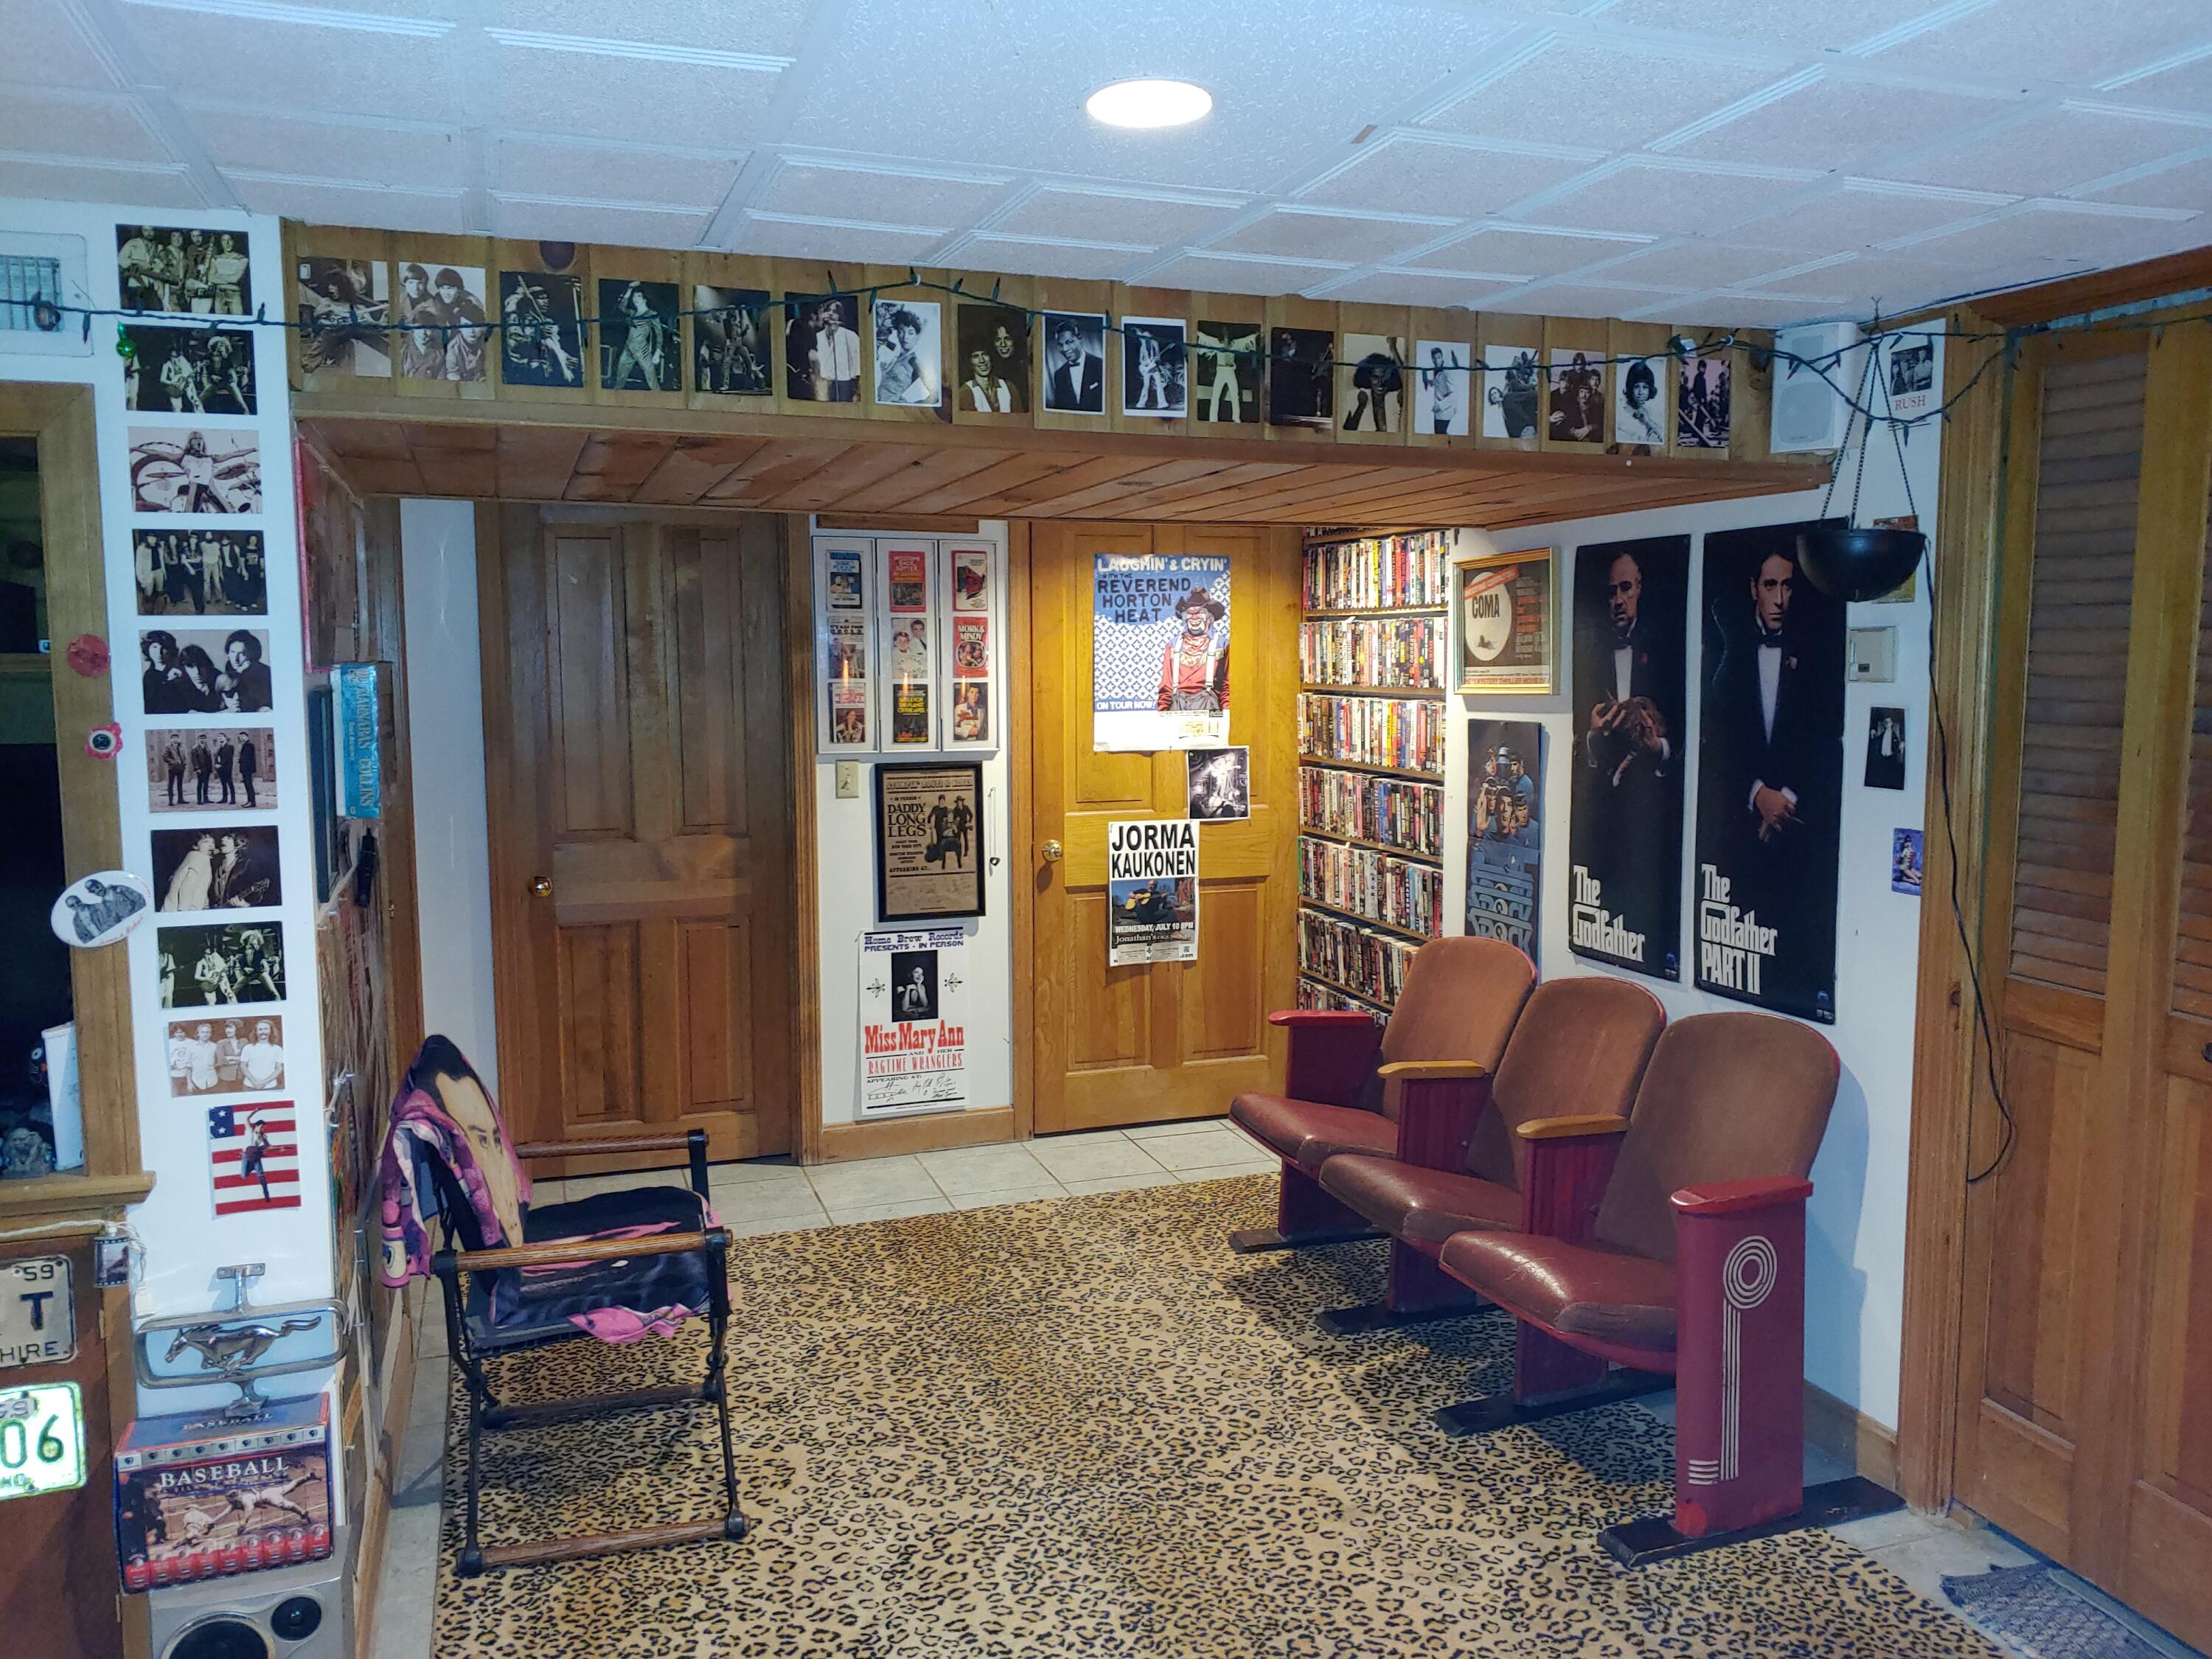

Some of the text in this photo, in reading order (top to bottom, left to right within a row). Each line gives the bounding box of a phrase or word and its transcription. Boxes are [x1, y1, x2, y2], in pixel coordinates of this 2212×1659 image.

[1893, 394, 1926, 411] RUSH
[1097, 557, 1227, 572] LAUGHIN' & CRYIN'
[1097, 577, 1192, 594] REVEREND
[1102, 593, 1172, 608] HORTON
[1472, 594, 1500, 619] COMA
[1115, 608, 1162, 623] HEAT
[1110, 700, 1133, 709] TOUR
[1134, 700, 1155, 709] NOW!
[358, 757, 374, 807] COLLINS
[887, 803, 926, 814] DADDY
[888, 813, 926, 826] LONG
[888, 824, 927, 838] LEGS
[1112, 823, 1195, 852] JORMA
[1112, 850, 1196, 878] KAUKONEN
[1573, 865, 1601, 906] The
[1701, 863, 1731, 903] The
[1116, 925, 1154, 933] WEDNESDAY,
[1573, 903, 1645, 962] Godfather
[1700, 900, 1778, 956] Godfather
[864, 931, 964, 945] Home Brew Records
[864, 943, 909, 952] PRESENTS
[930, 940, 964, 948] PERSON
[1116, 933, 1156, 944] Jonathan's
[1701, 941, 1761, 995] PART II
[864, 1020, 964, 1054] Miss Mary Ann
[869, 1053, 962, 1075] RAGTIME WRANGLERS
[867, 1075, 909, 1083] APPEARING
[23, 1264, 54, 1281] 59
[19, 1291, 54, 1331] T
[159, 1456, 290, 1488] BASEBALL
